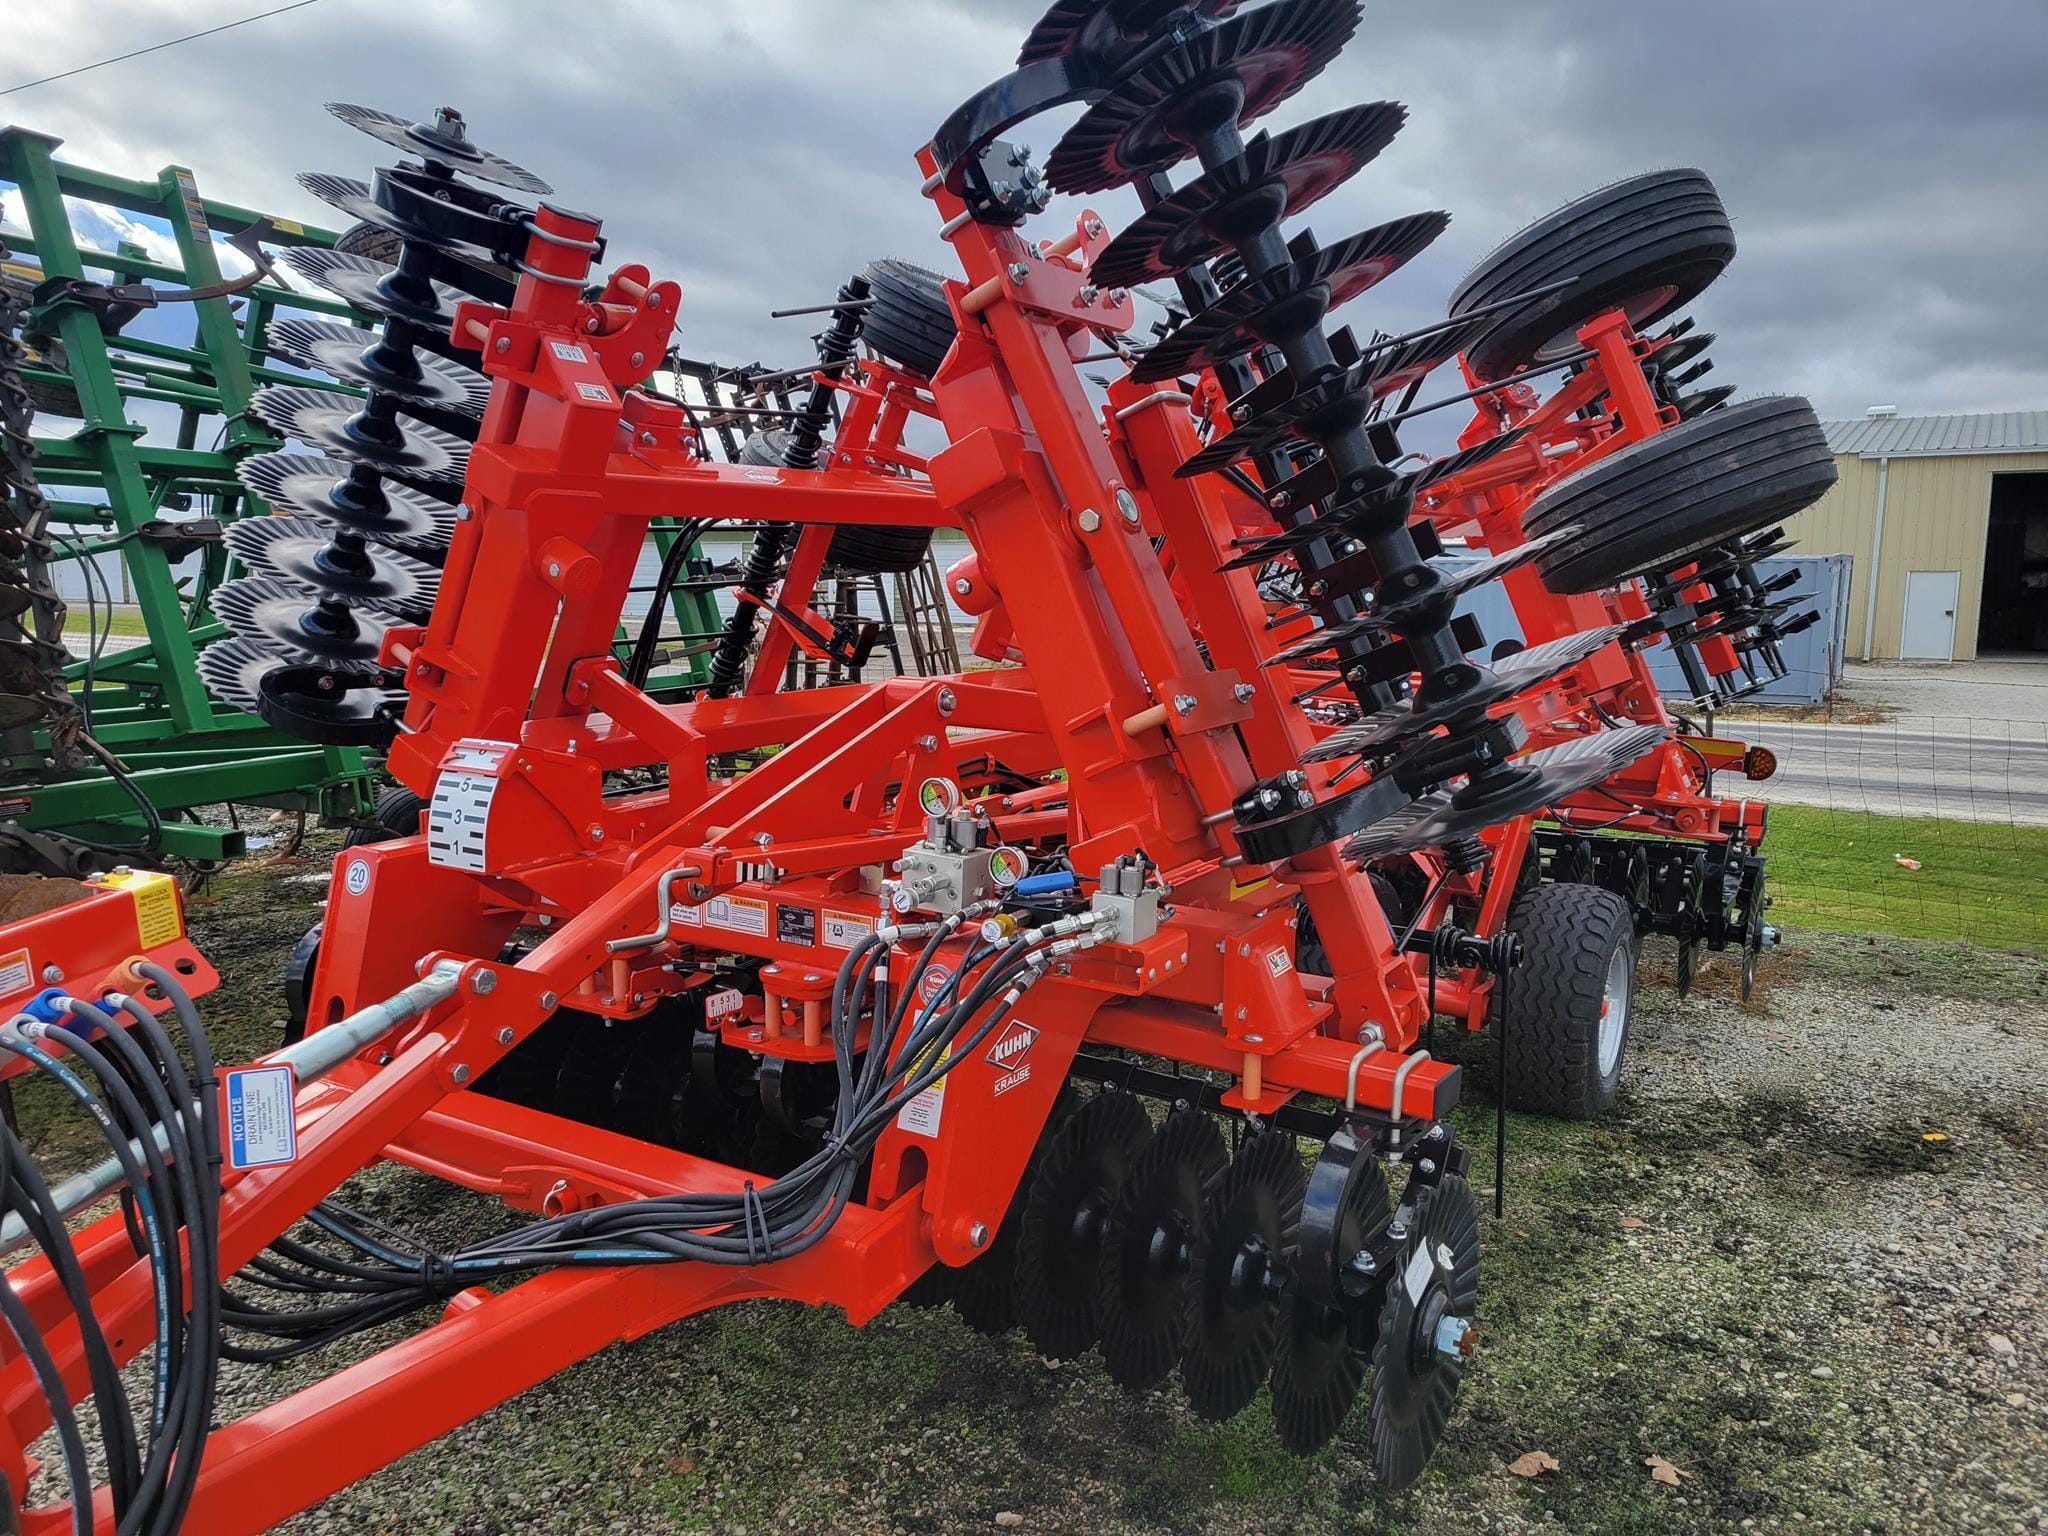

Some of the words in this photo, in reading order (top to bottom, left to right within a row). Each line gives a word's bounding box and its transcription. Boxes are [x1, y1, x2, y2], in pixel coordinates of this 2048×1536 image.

[461, 777, 472, 792] 5
[453, 809, 462, 824] 3
[453, 840, 459, 855] 1
[351, 867, 365, 883] 20
[739, 900, 761, 908] WARNING
[726, 995, 730, 1003] 3
[995, 1030, 1032, 1062] KUHN
[994, 1067, 1031, 1093] KRAUSE
[246, 1091, 255, 1113] LINE
[232, 1097, 244, 1141] NOTICE
[247, 1115, 257, 1145] DRAIN
